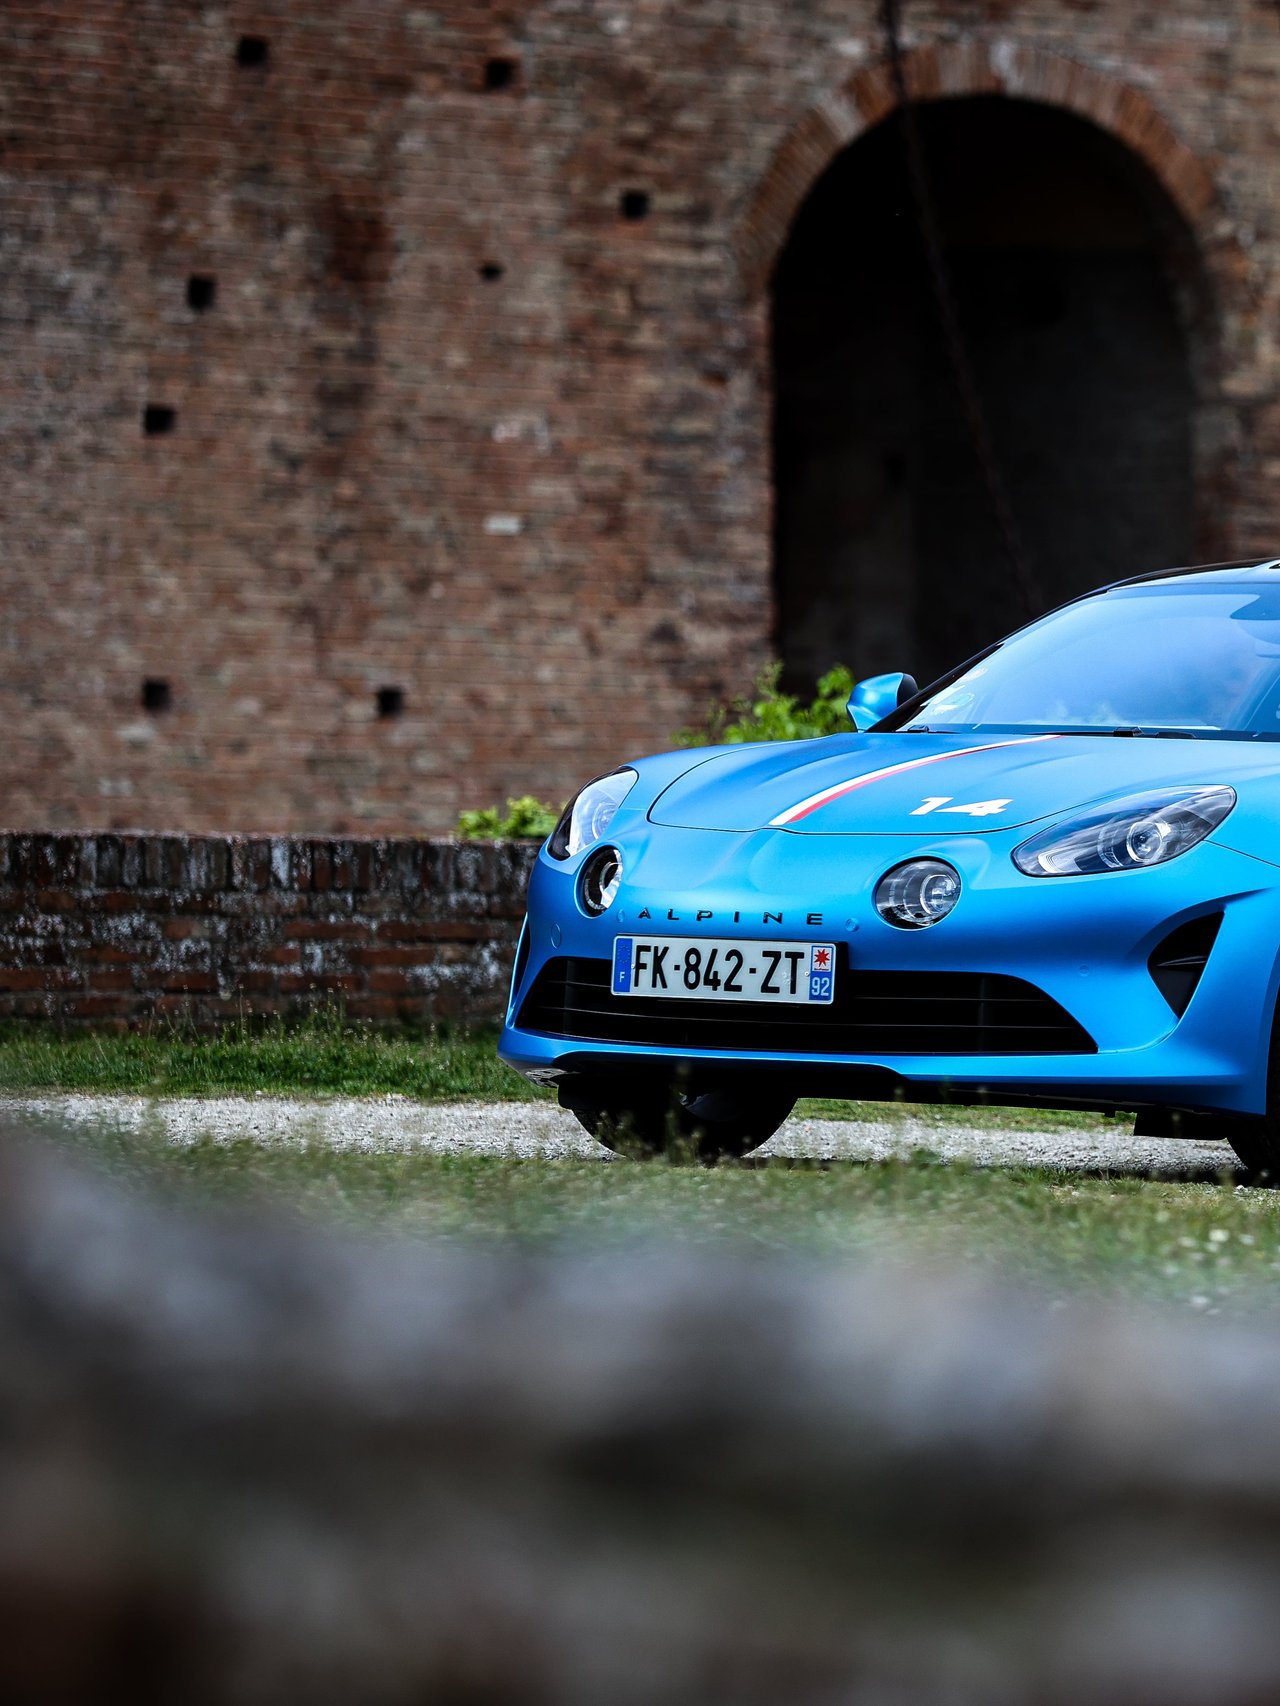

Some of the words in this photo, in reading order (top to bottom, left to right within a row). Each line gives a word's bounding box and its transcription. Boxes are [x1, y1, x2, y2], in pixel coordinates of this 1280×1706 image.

[908, 796, 1015, 816] 14
[638, 907, 823, 925] ALPINE
[619, 971, 625, 983] F
[633, 944, 805, 995] FK-842-ZT
[811, 977, 830, 996] 92
